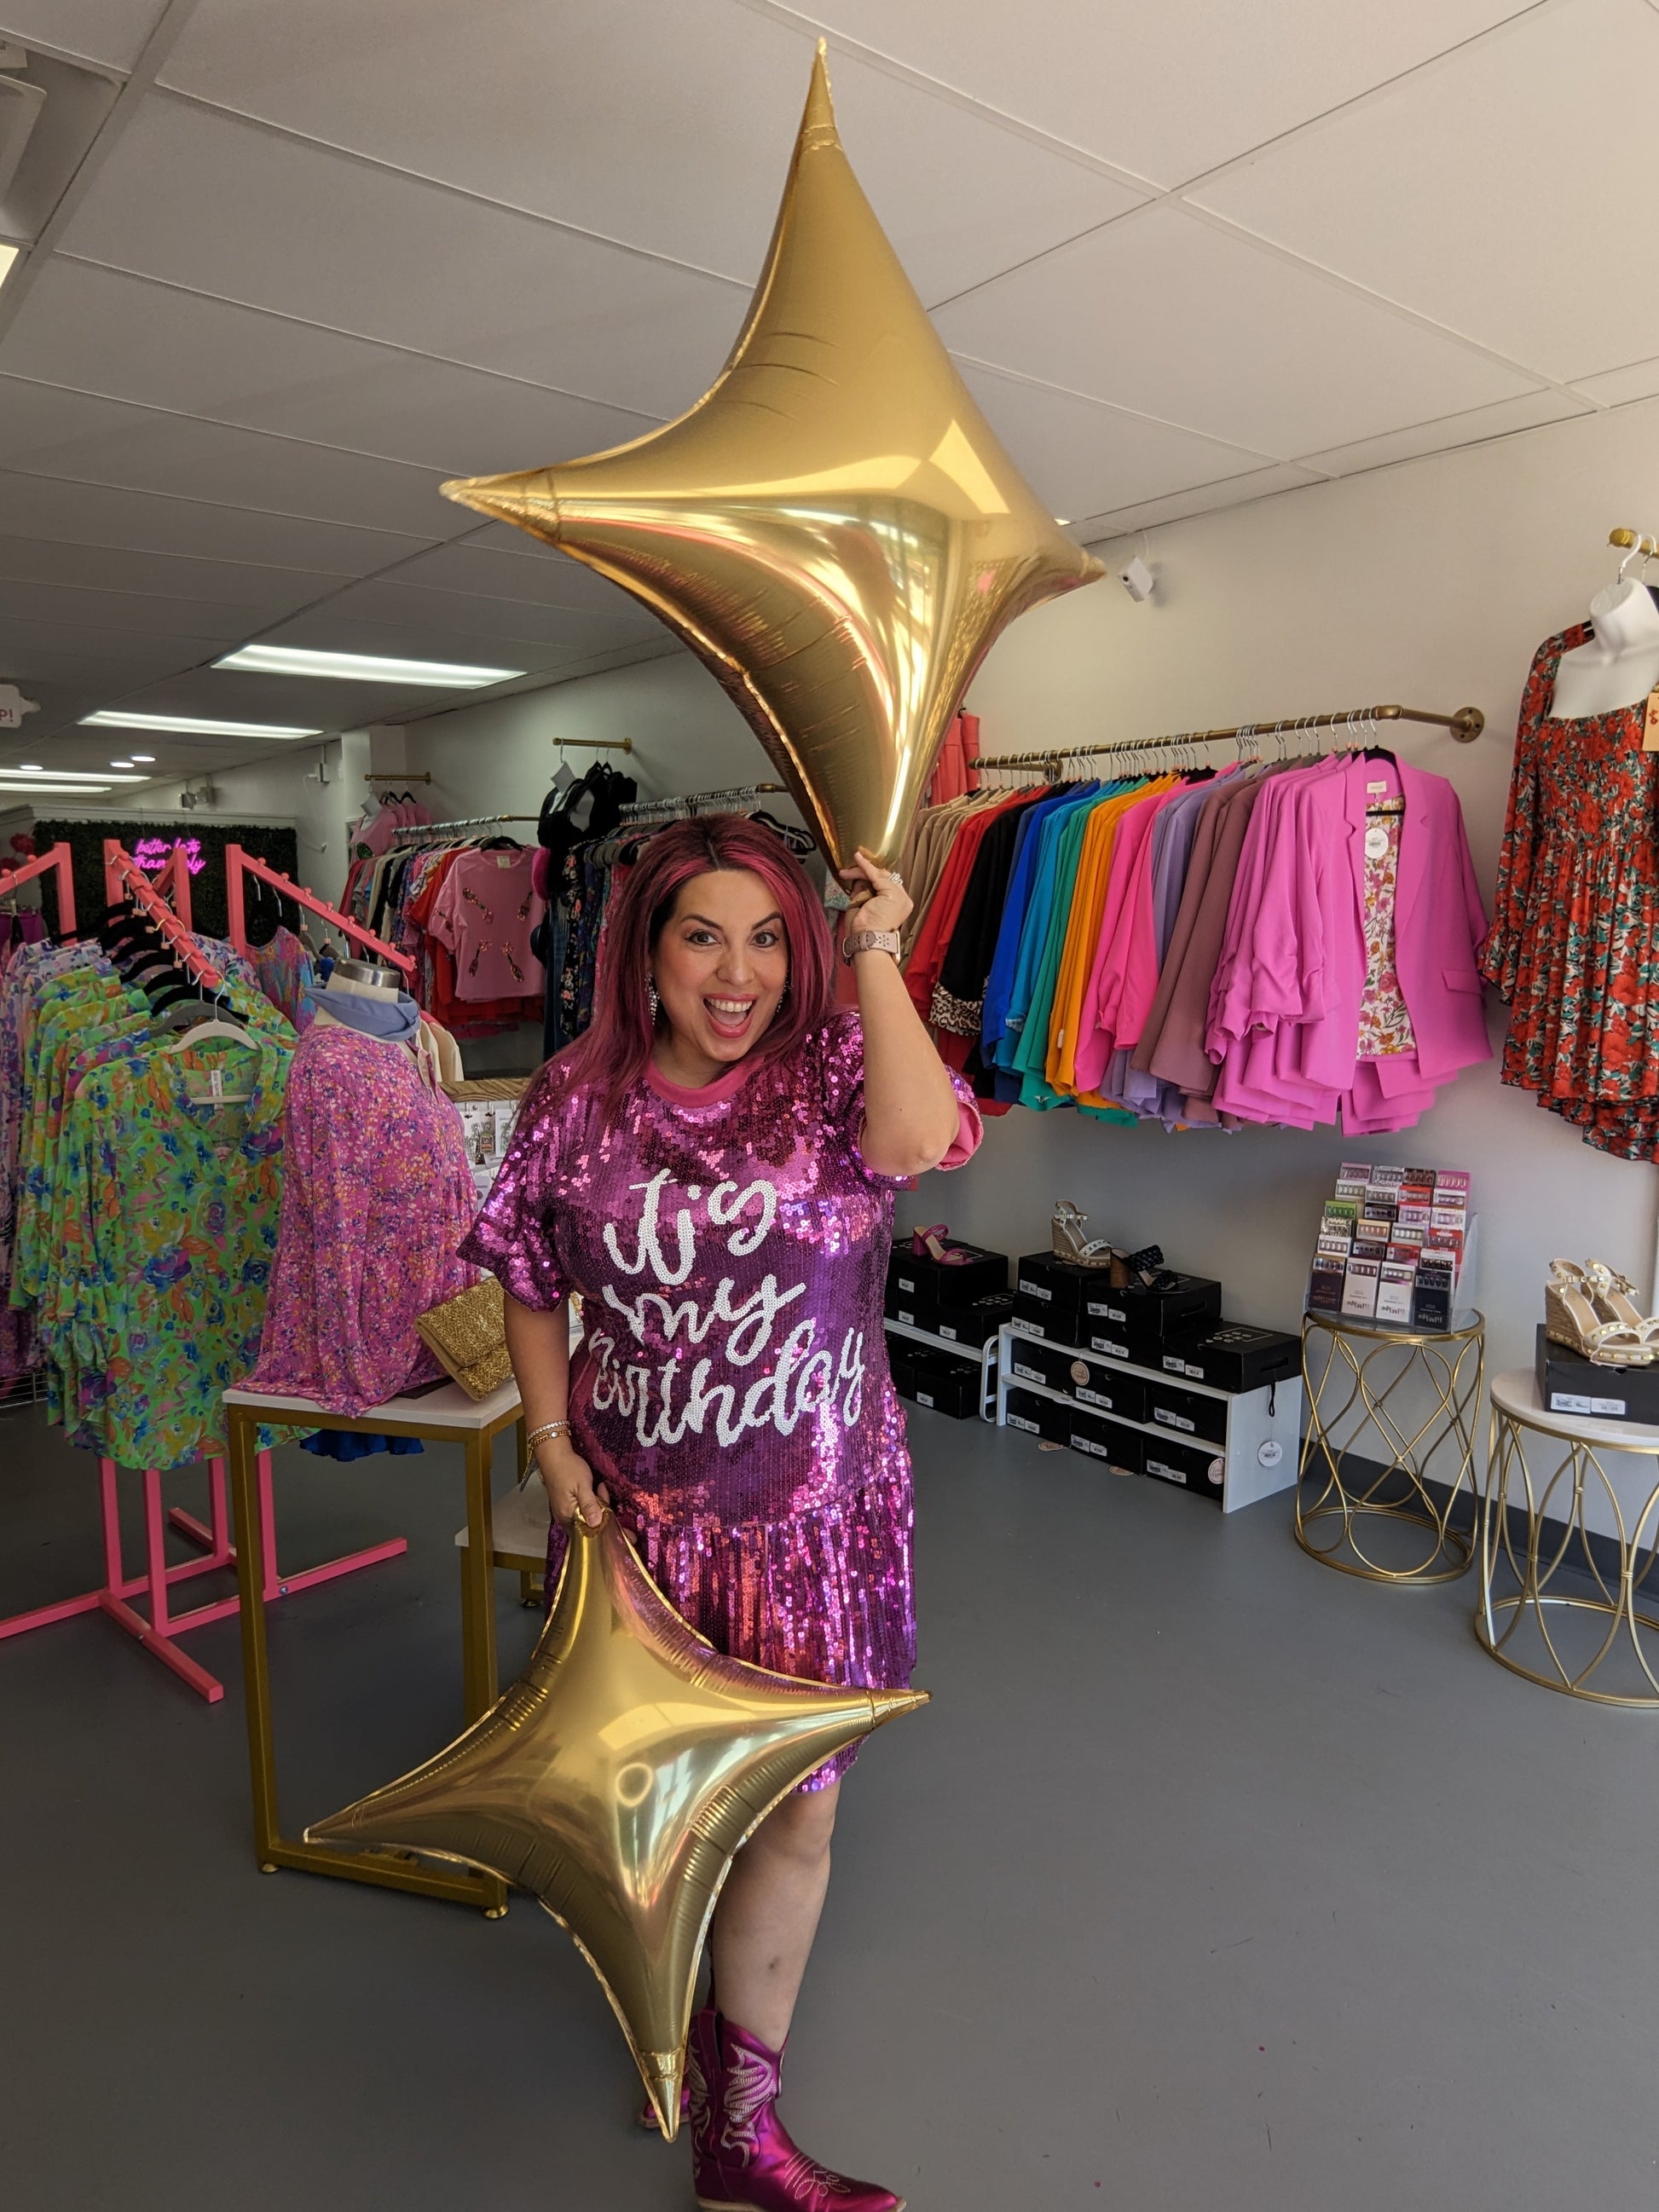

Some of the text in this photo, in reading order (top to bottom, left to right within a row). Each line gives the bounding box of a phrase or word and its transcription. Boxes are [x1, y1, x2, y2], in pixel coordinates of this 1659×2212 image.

[136, 838, 172, 854] better
[134, 854, 167, 869] than
[602, 1274, 806, 1366] my
